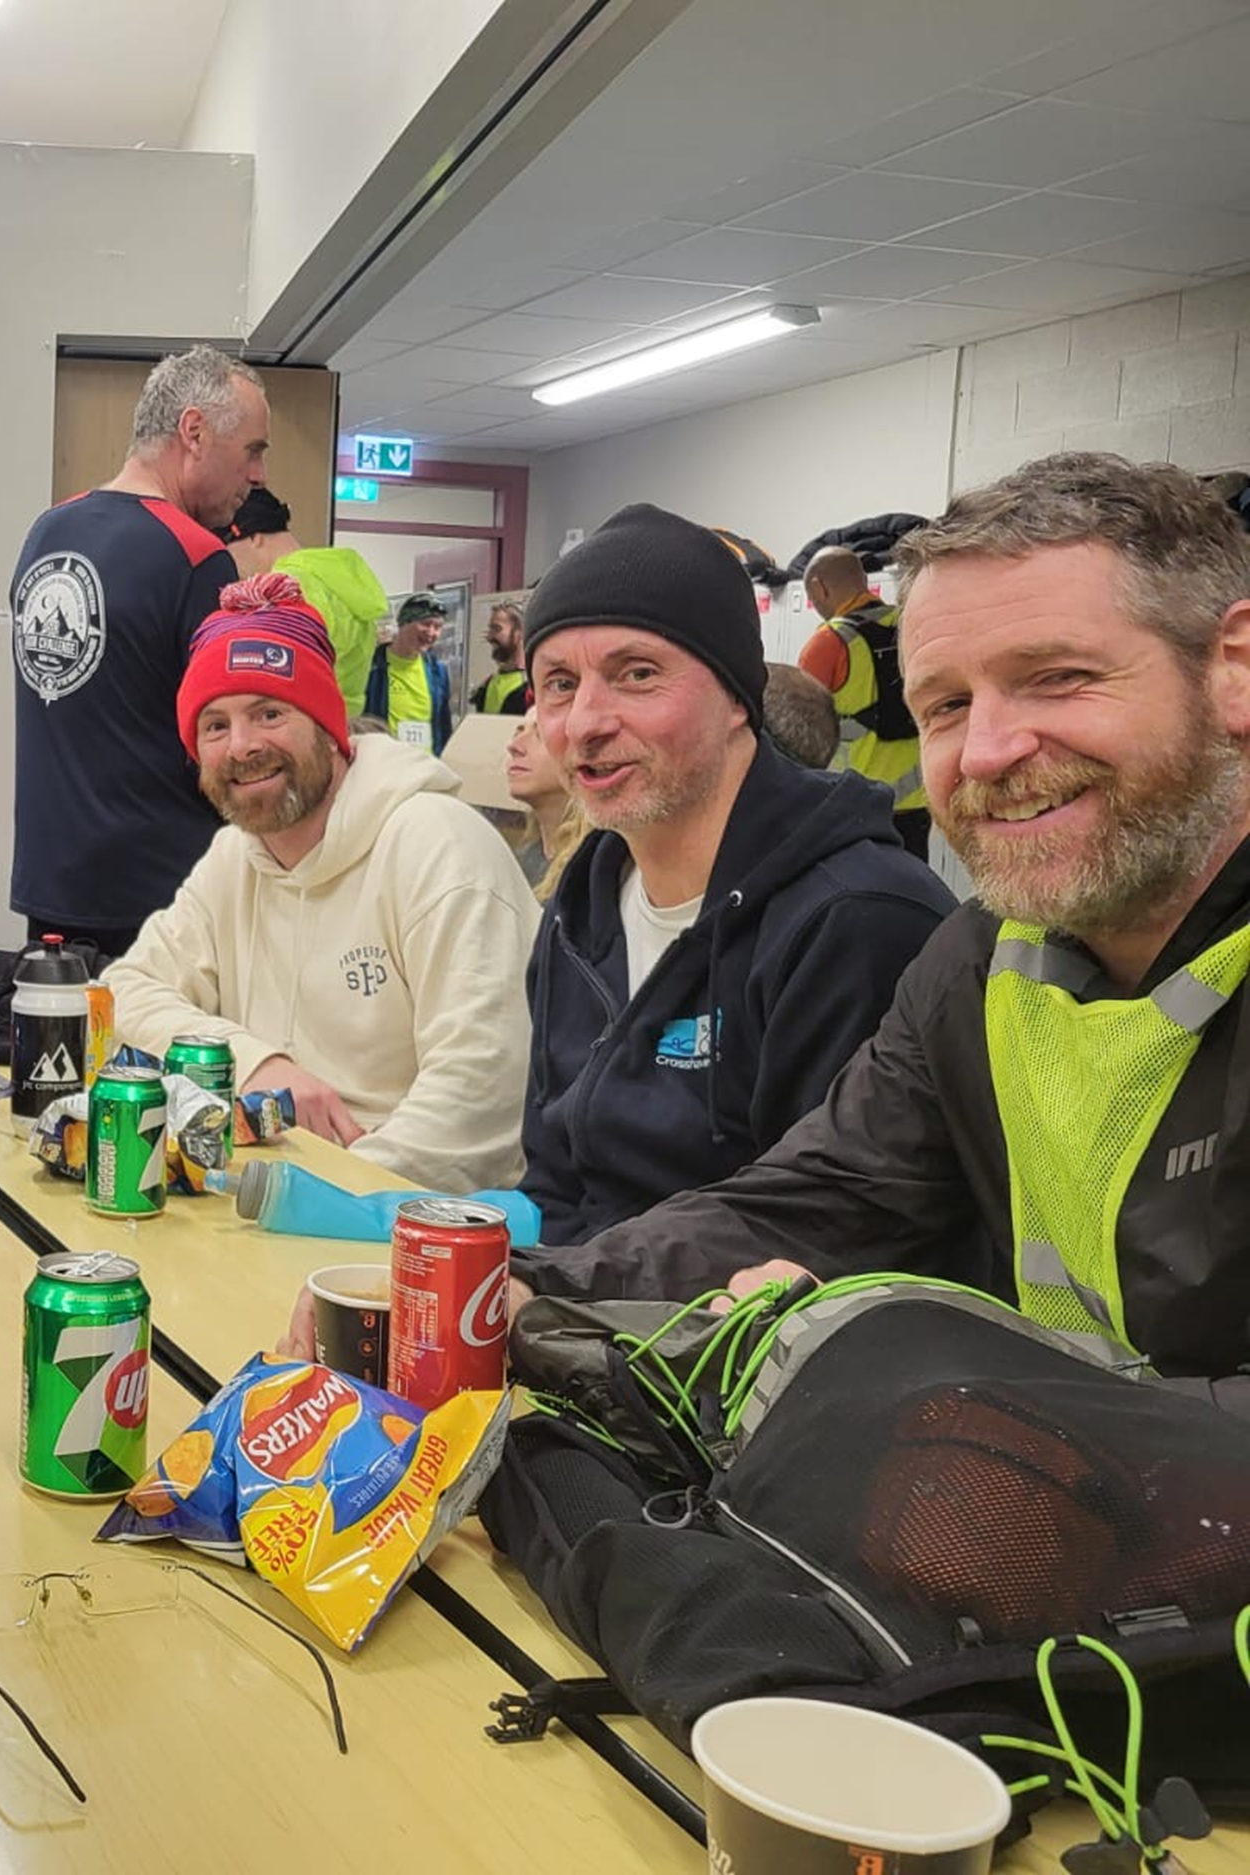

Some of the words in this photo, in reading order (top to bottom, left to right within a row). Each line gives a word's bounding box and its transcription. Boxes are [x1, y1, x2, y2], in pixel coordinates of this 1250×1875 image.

[248, 1374, 347, 1468] WALKERS
[408, 1434, 448, 1497] GREAT
[270, 1508, 320, 1575] 50%
